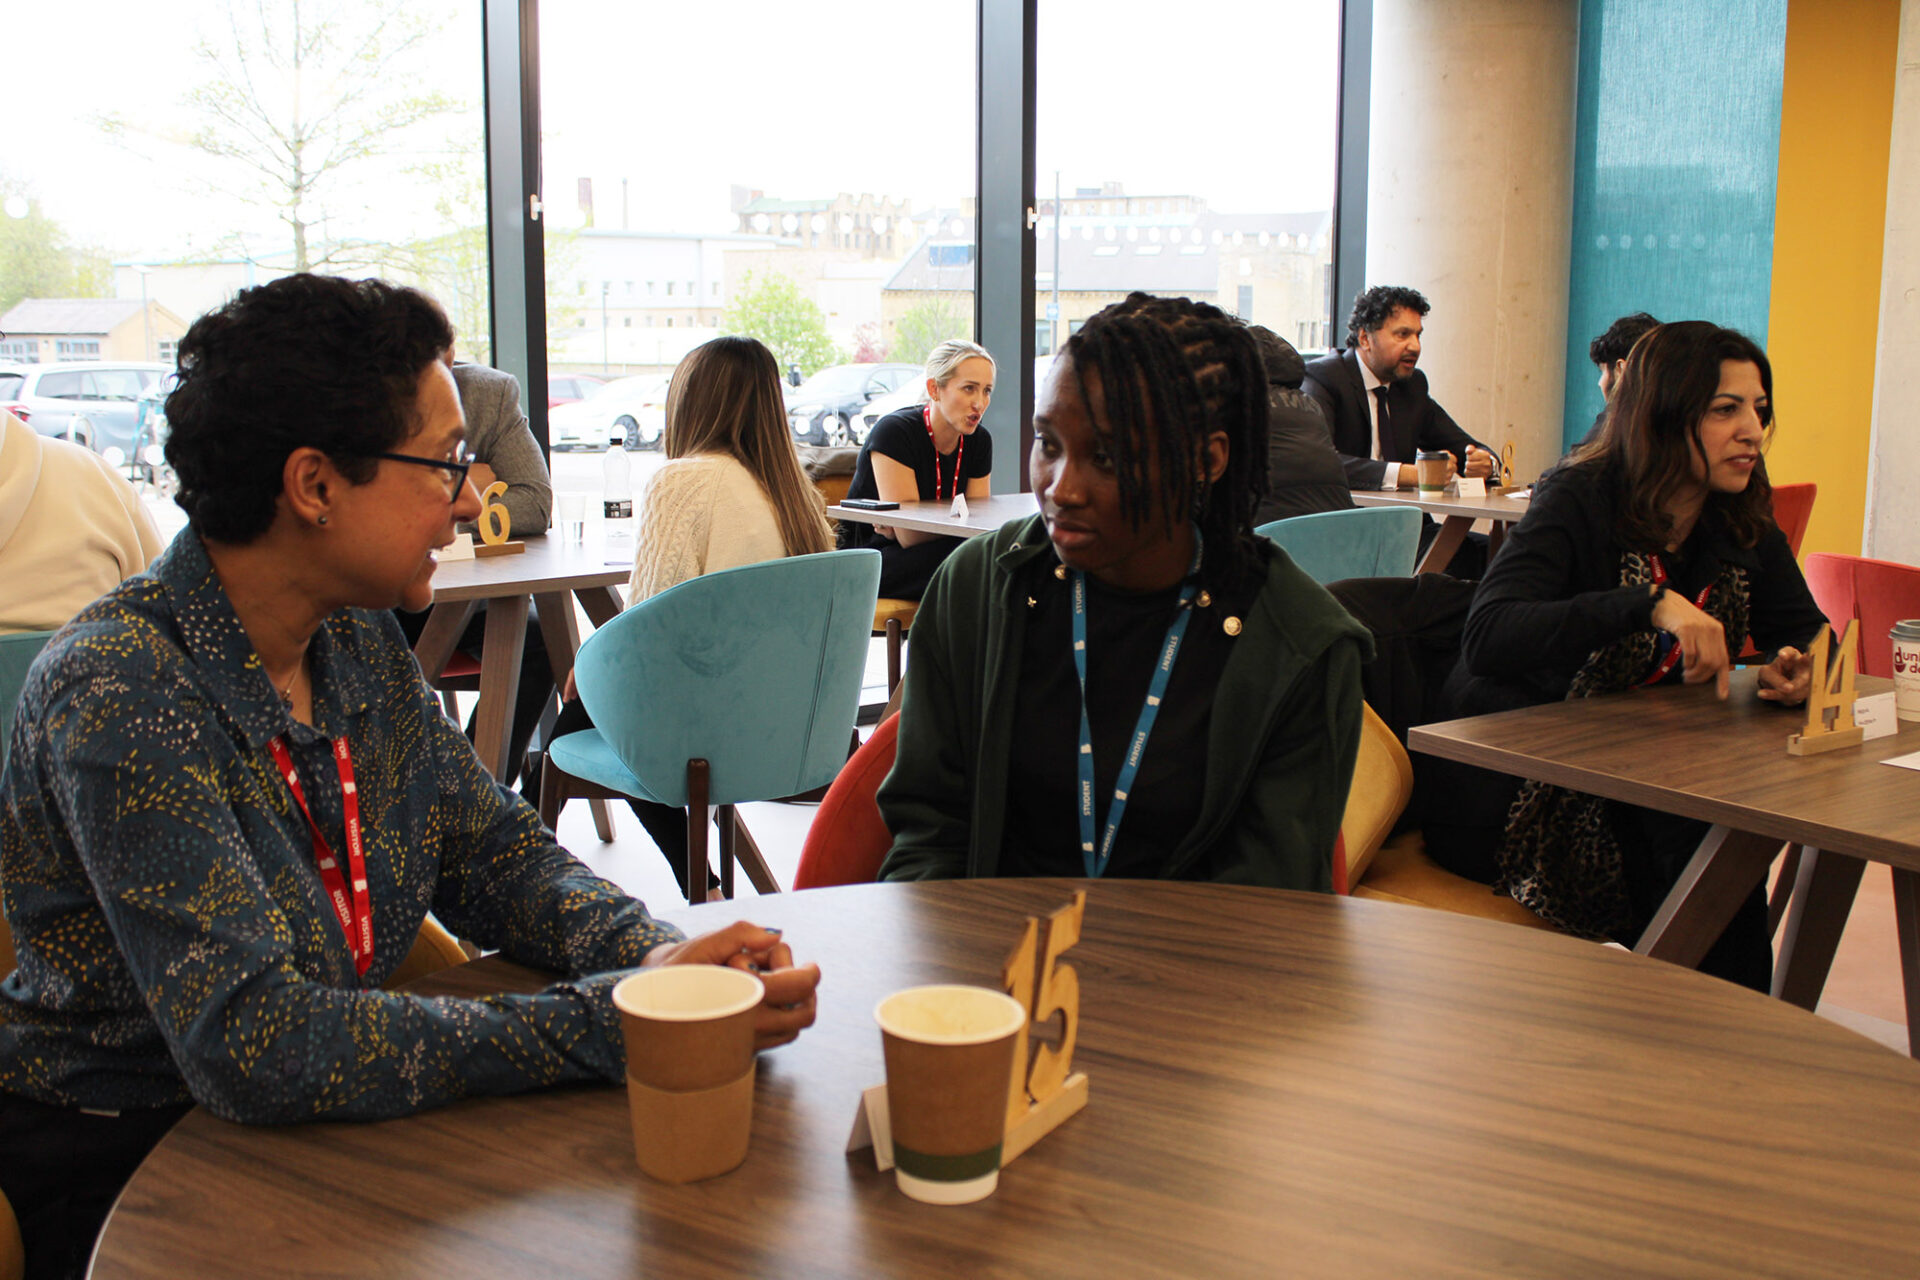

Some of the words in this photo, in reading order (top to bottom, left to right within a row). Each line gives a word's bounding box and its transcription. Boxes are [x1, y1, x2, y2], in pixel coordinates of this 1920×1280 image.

[1501, 440, 1516, 488] 8
[478, 481, 511, 545] 6
[1161, 635, 1178, 671] STUDENT
[1803, 618, 1859, 737] 14
[1129, 731, 1146, 768] STUDENT
[1082, 780, 1091, 816] STUDENT
[349, 818, 361, 857] VISITOR
[1102, 823, 1116, 859] STUDENT
[333, 888, 352, 927] VISITOR
[360, 916, 372, 955] VISITOR
[1002, 890, 1086, 1131] 15
